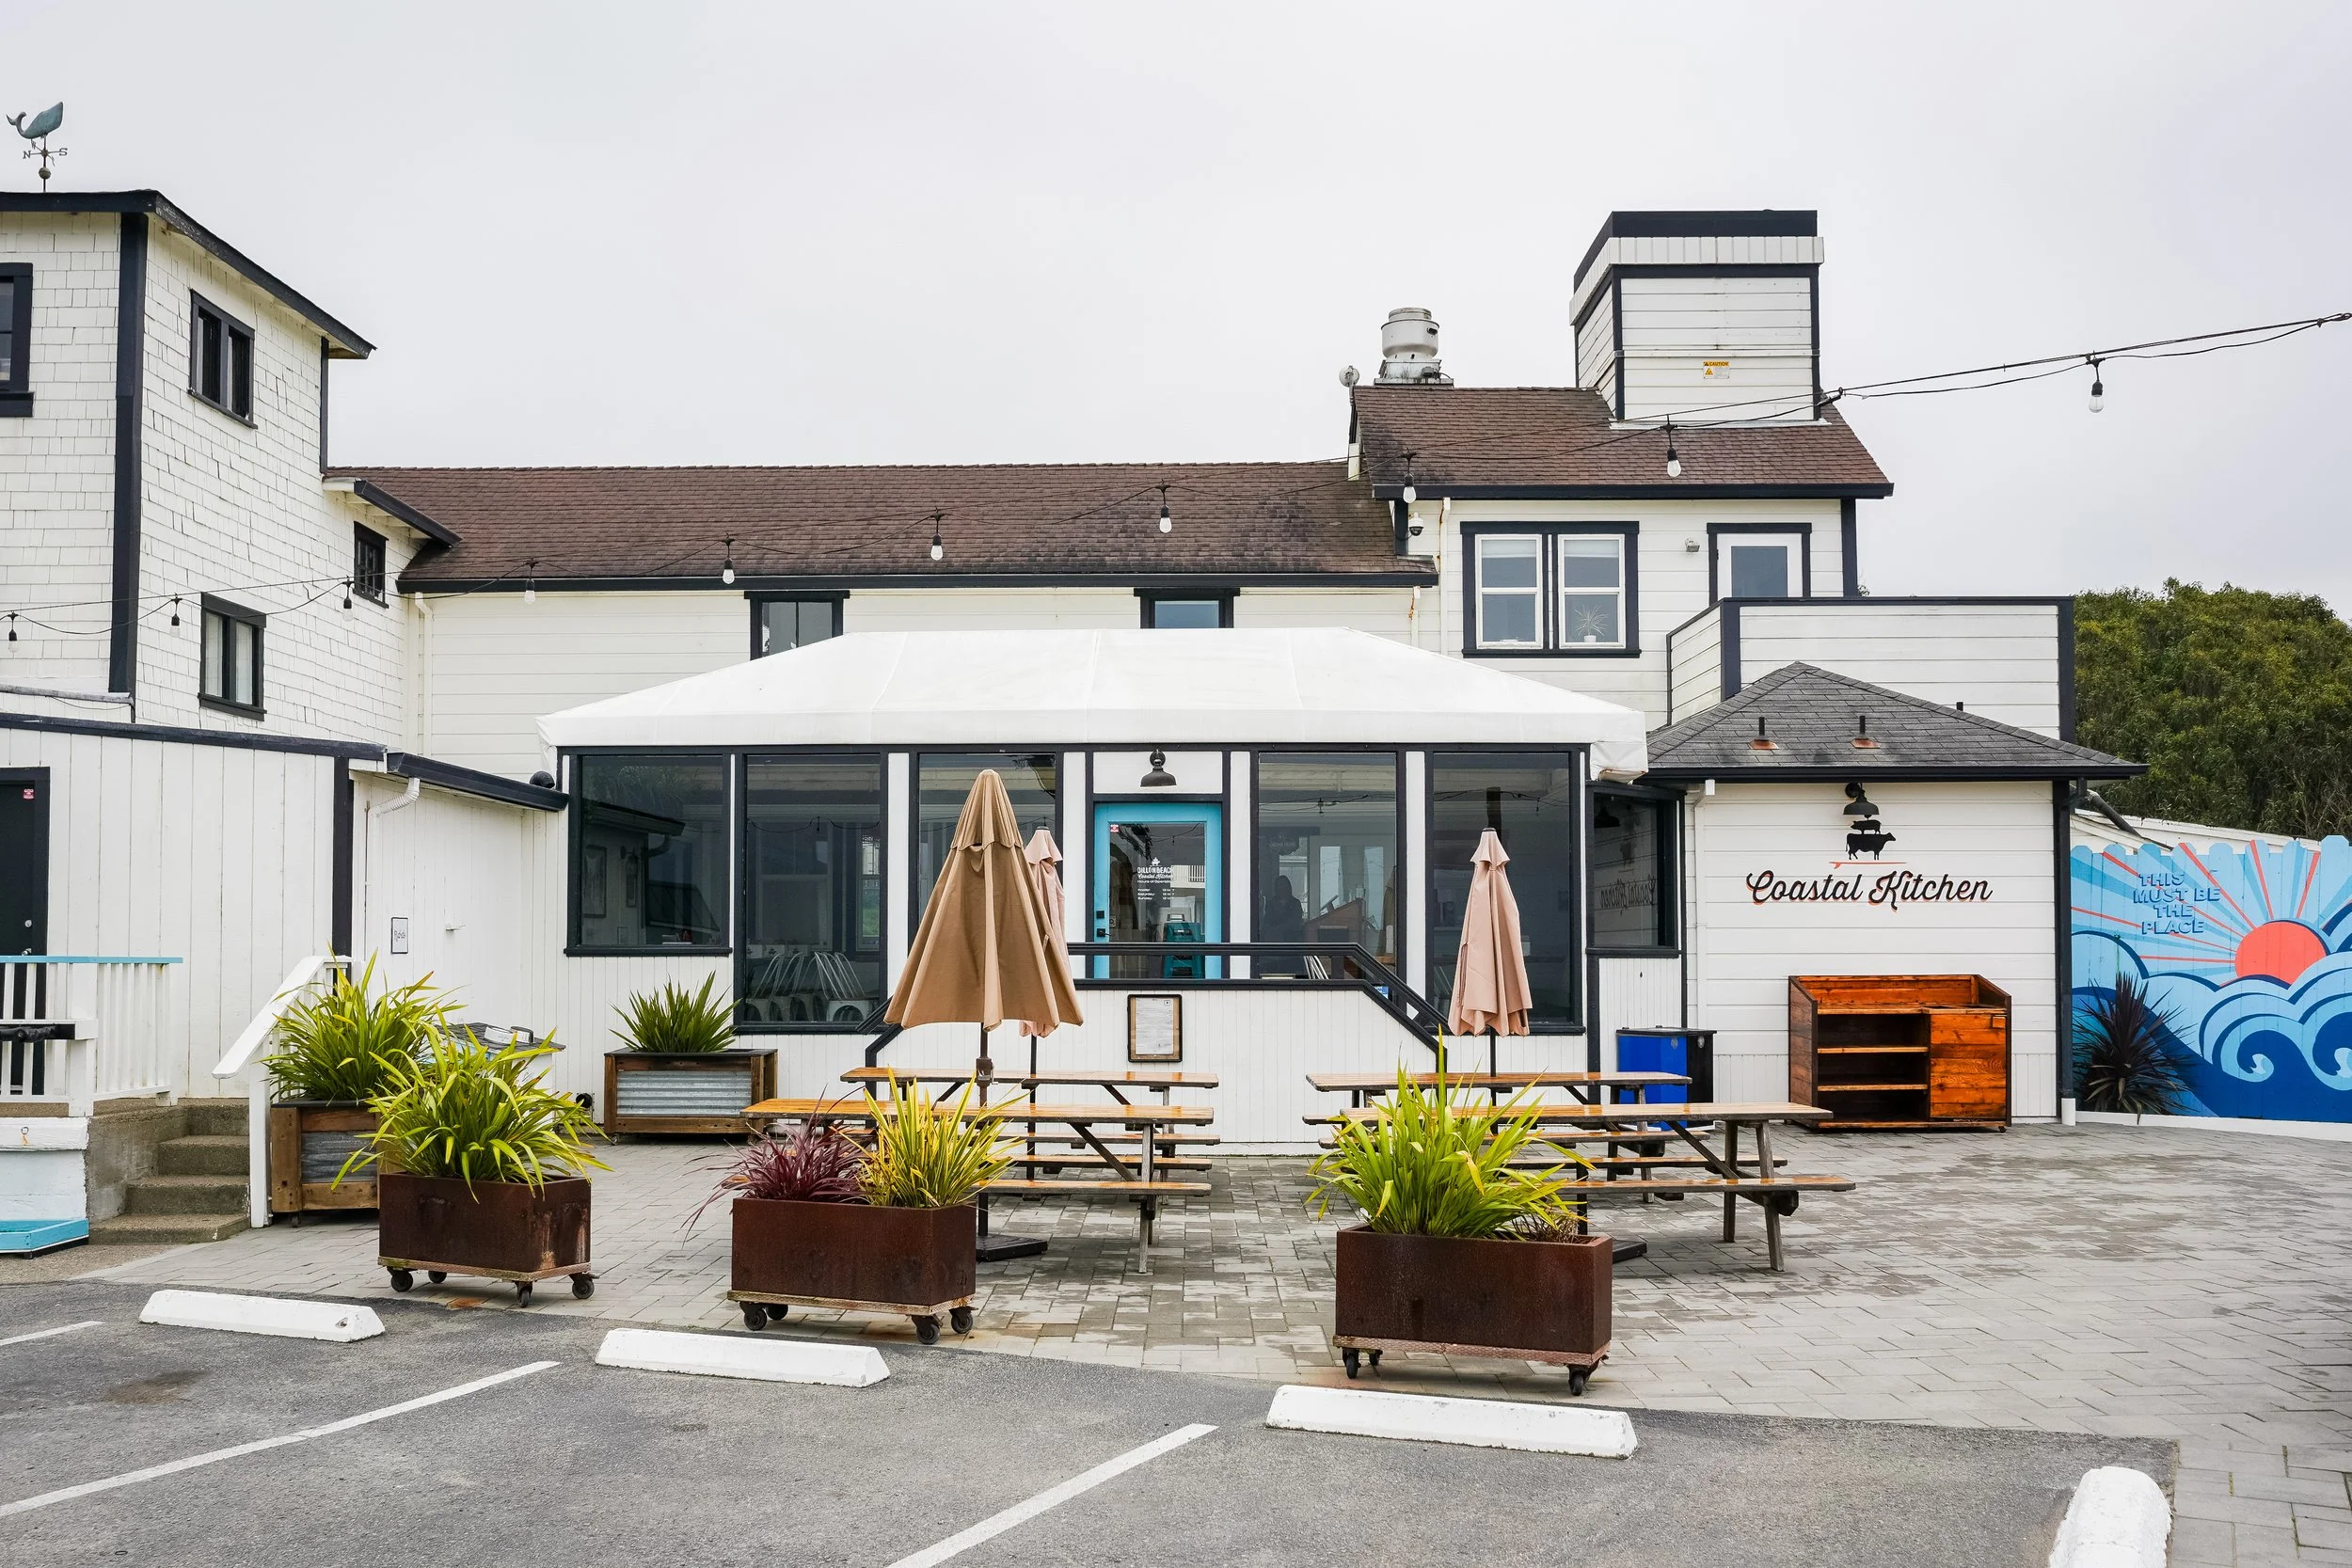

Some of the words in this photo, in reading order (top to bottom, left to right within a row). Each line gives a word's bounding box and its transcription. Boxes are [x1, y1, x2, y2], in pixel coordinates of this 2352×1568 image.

[23, 150, 32, 159] N
[58, 148, 68, 156] S
[2138, 873, 2185, 887] THIS
[1746, 870, 1864, 905] Coastal
[1868, 870, 1994, 912] Kitchen
[2133, 888, 2188, 903] MUST
[2194, 887, 2221, 902] BE
[2153, 904, 2194, 918] THE
[2141, 920, 2205, 935] PLACE
